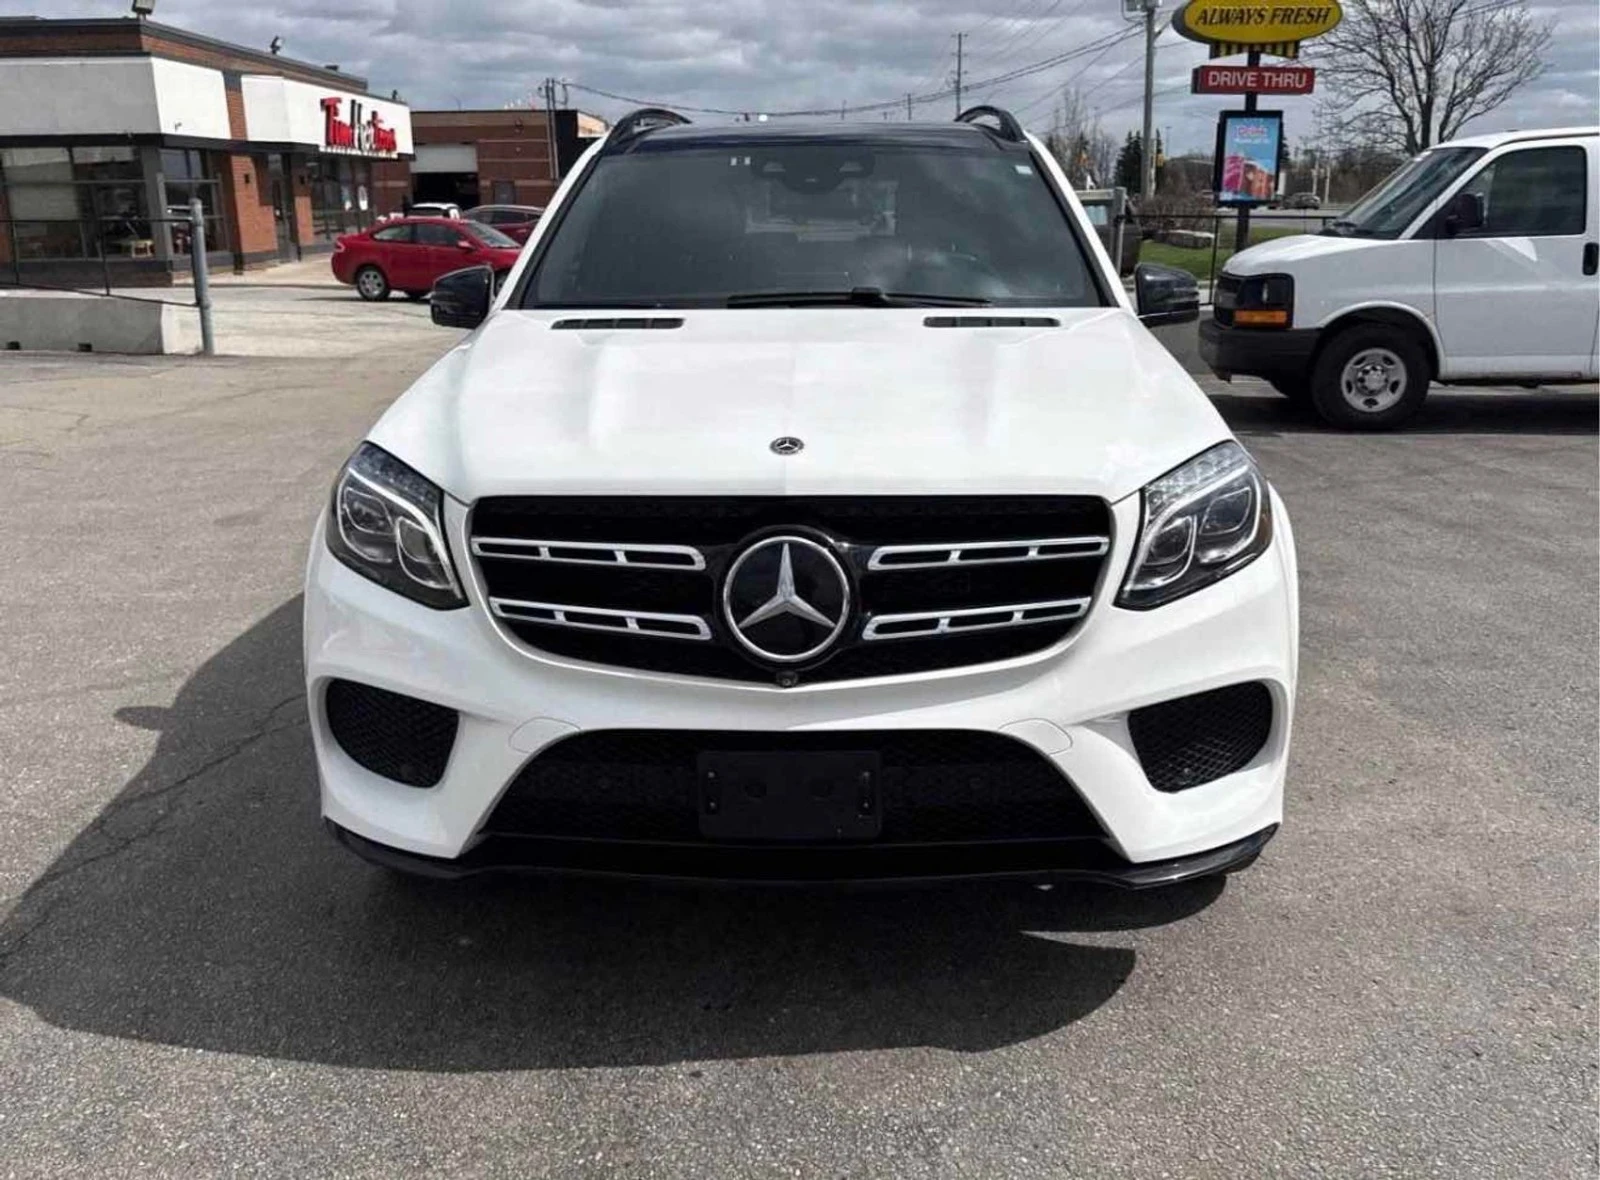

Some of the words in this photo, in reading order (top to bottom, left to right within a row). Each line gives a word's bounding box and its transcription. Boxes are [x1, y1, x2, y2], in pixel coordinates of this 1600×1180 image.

[1195, 7, 1268, 25] ALWAYS
[1269, 7, 1331, 25] FRESH
[1208, 71, 1258, 87] DRIVE
[1261, 72, 1307, 89] THRU
